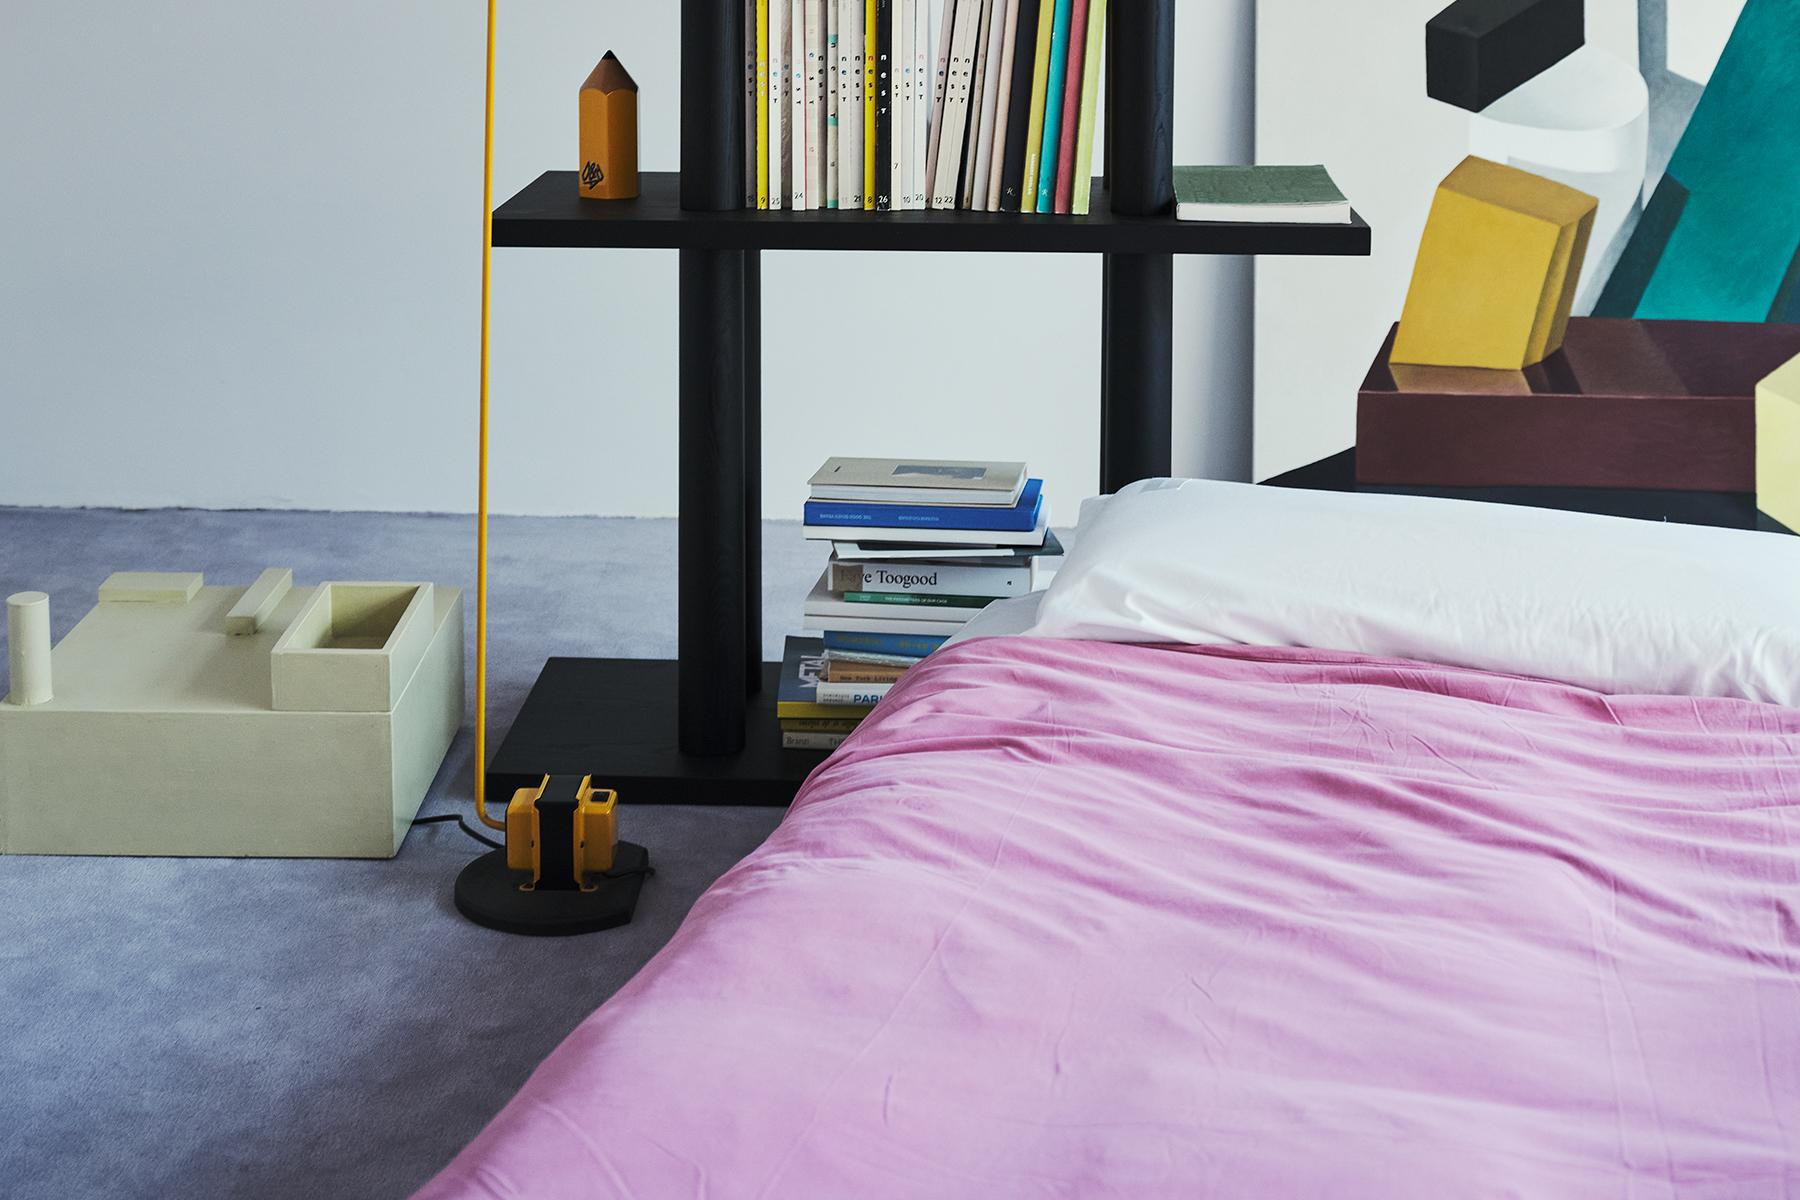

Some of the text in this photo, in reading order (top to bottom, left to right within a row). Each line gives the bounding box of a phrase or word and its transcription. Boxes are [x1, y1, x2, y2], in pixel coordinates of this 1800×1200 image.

[878, 195, 888, 203] 26
[944, 196, 954, 204] 22
[876, 569, 938, 588] Toogood
